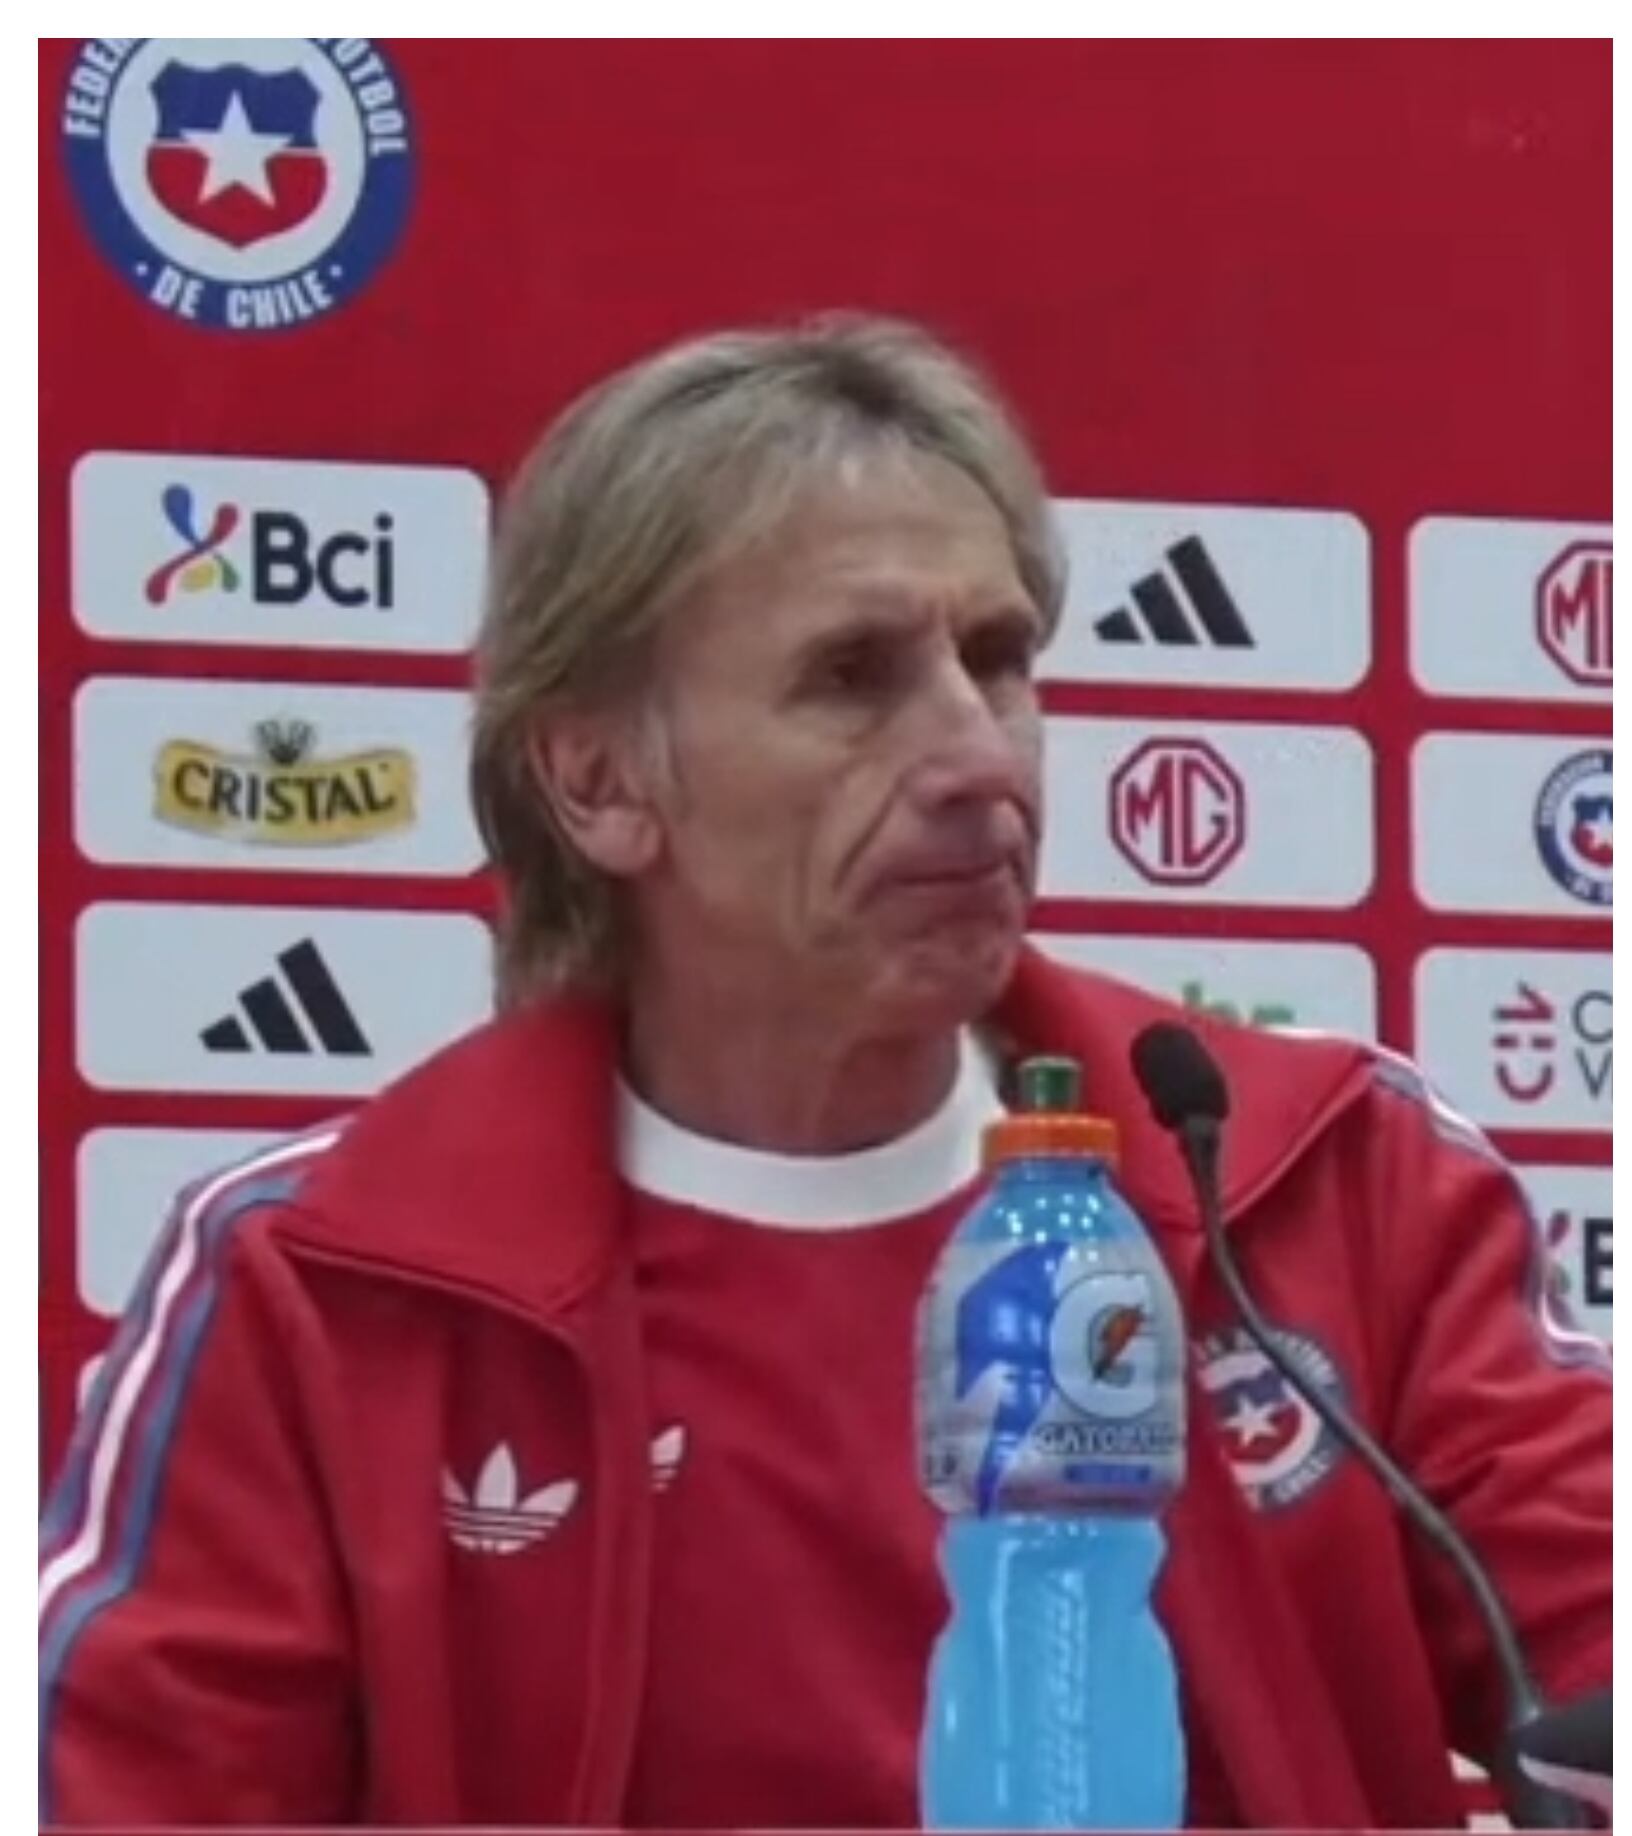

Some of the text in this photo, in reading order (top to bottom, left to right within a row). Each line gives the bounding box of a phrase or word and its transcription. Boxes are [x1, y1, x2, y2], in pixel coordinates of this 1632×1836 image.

[320, 38, 407, 156] UTBOL
[150, 265, 333, 329] DE CHILE
[252, 510, 394, 610] Bci
[172, 760, 398, 825] CRISTAL
[1122, 752, 1232, 872] MG
